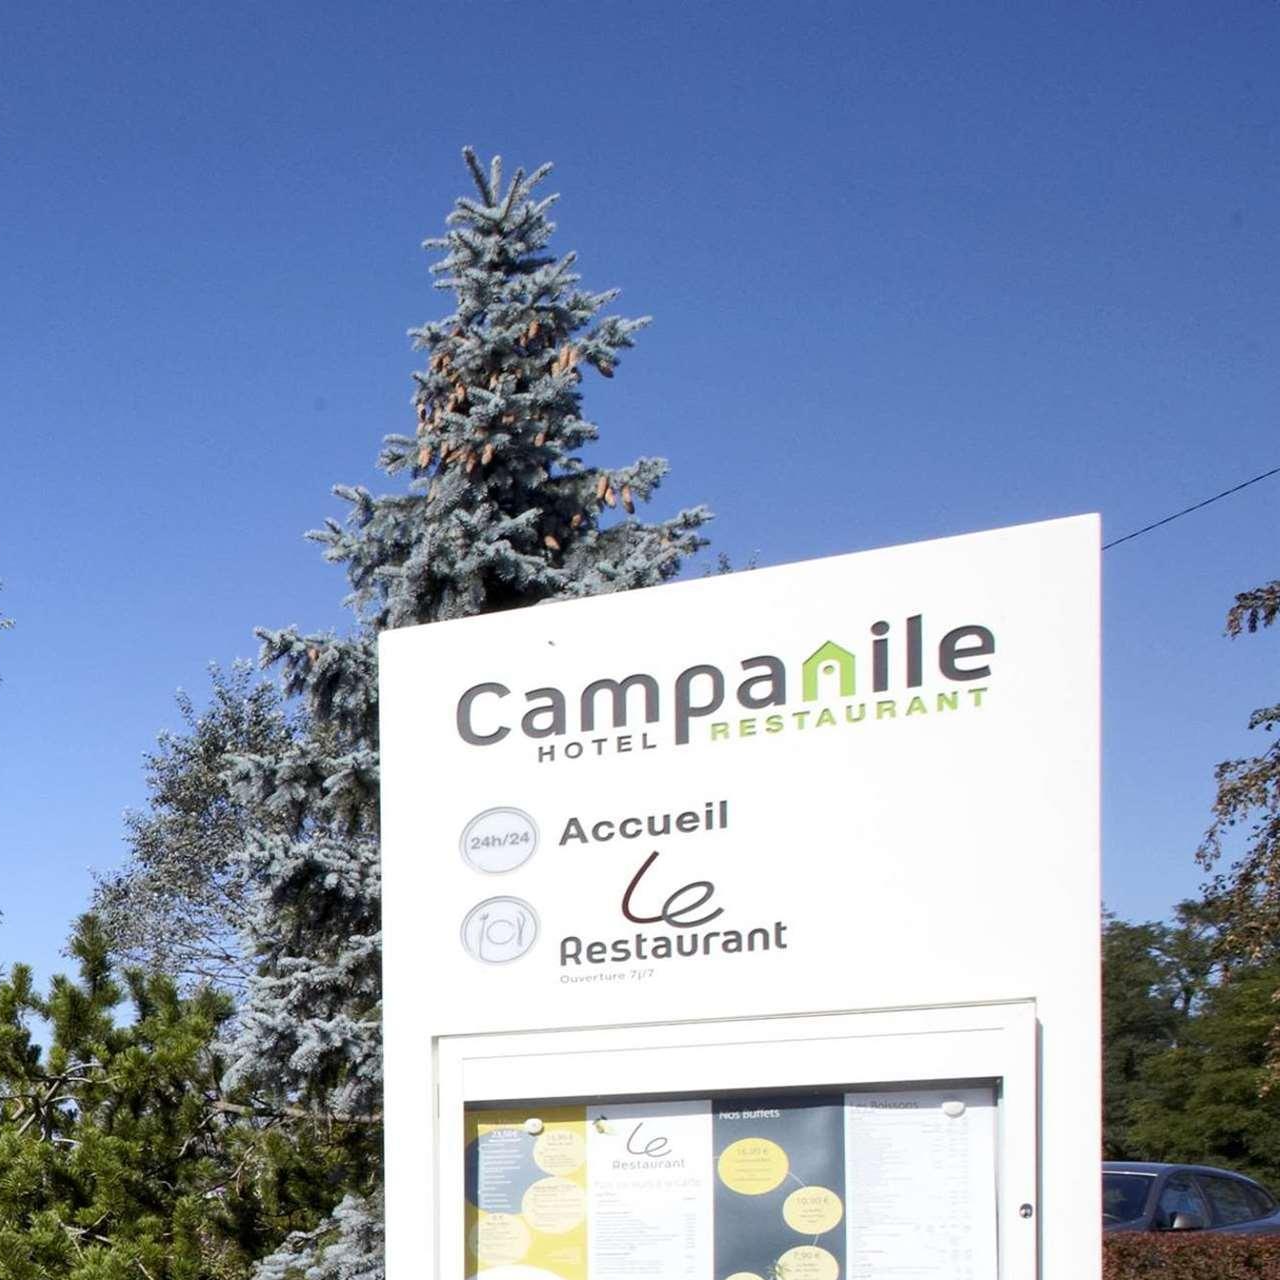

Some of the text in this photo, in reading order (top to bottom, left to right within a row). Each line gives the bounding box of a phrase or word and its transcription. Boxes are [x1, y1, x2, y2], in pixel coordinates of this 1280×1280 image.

[456, 614, 997, 746] Campanile
[537, 686, 991, 763] HOTEL RESTAURANT
[469, 830, 532, 851] 24h/24
[558, 800, 730, 846] Accueil
[621, 850, 725, 928] Le
[559, 920, 789, 967] Restaurant
[559, 973, 626, 985] Ouverture
[626, 1121, 673, 1158] Le
[612, 1158, 687, 1171] Restaurant
